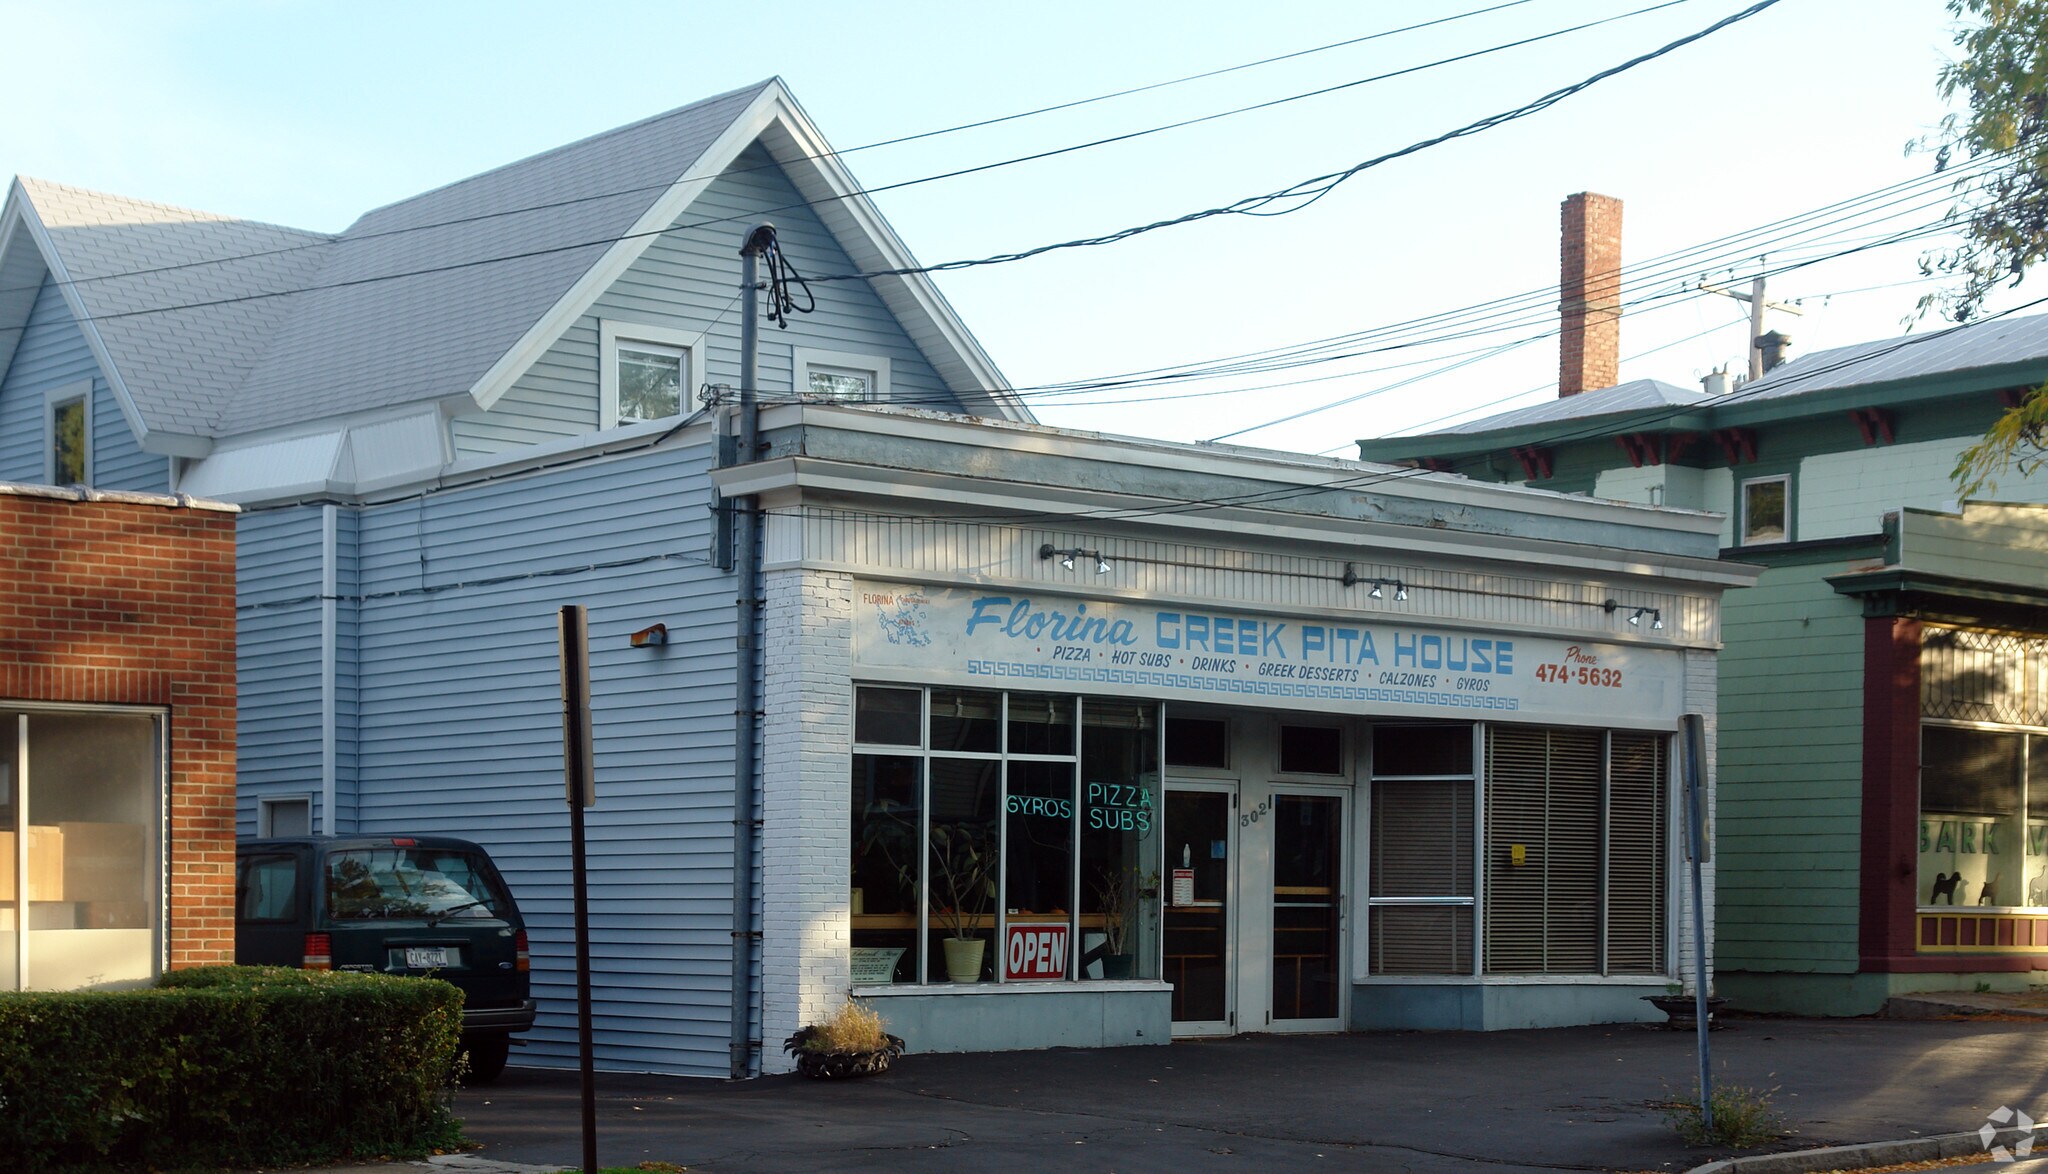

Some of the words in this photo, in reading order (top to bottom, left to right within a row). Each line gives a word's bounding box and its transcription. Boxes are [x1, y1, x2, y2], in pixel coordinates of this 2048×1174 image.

[863, 593, 894, 606] FLORINA
[965, 596, 1138, 646] Florina
[1156, 612, 1287, 659] GREEK
[1302, 625, 1380, 666] PITA
[1394, 632, 1513, 675] HOUSE
[1564, 645, 1599, 665] Phone
[1052, 645, 1092, 662] PIZZA
[1111, 650, 1137, 666] HOT
[1138, 652, 1172, 669] SUBS
[1191, 656, 1237, 673] DRINKS
[1258, 662, 1297, 679] GREEK
[1298, 665, 1360, 683] DESSERTS
[1379, 671, 1437, 688] CALZONES
[1456, 677, 1491, 692] GYROS
[1005, 795, 1072, 819] GYROS
[1088, 783, 1152, 807] PIZZA
[1089, 808, 1150, 832] SUBS
[1241, 802, 1268, 828] 302
[1919, 820, 2001, 854] BARK
[1009, 931, 1066, 975] OPEN
